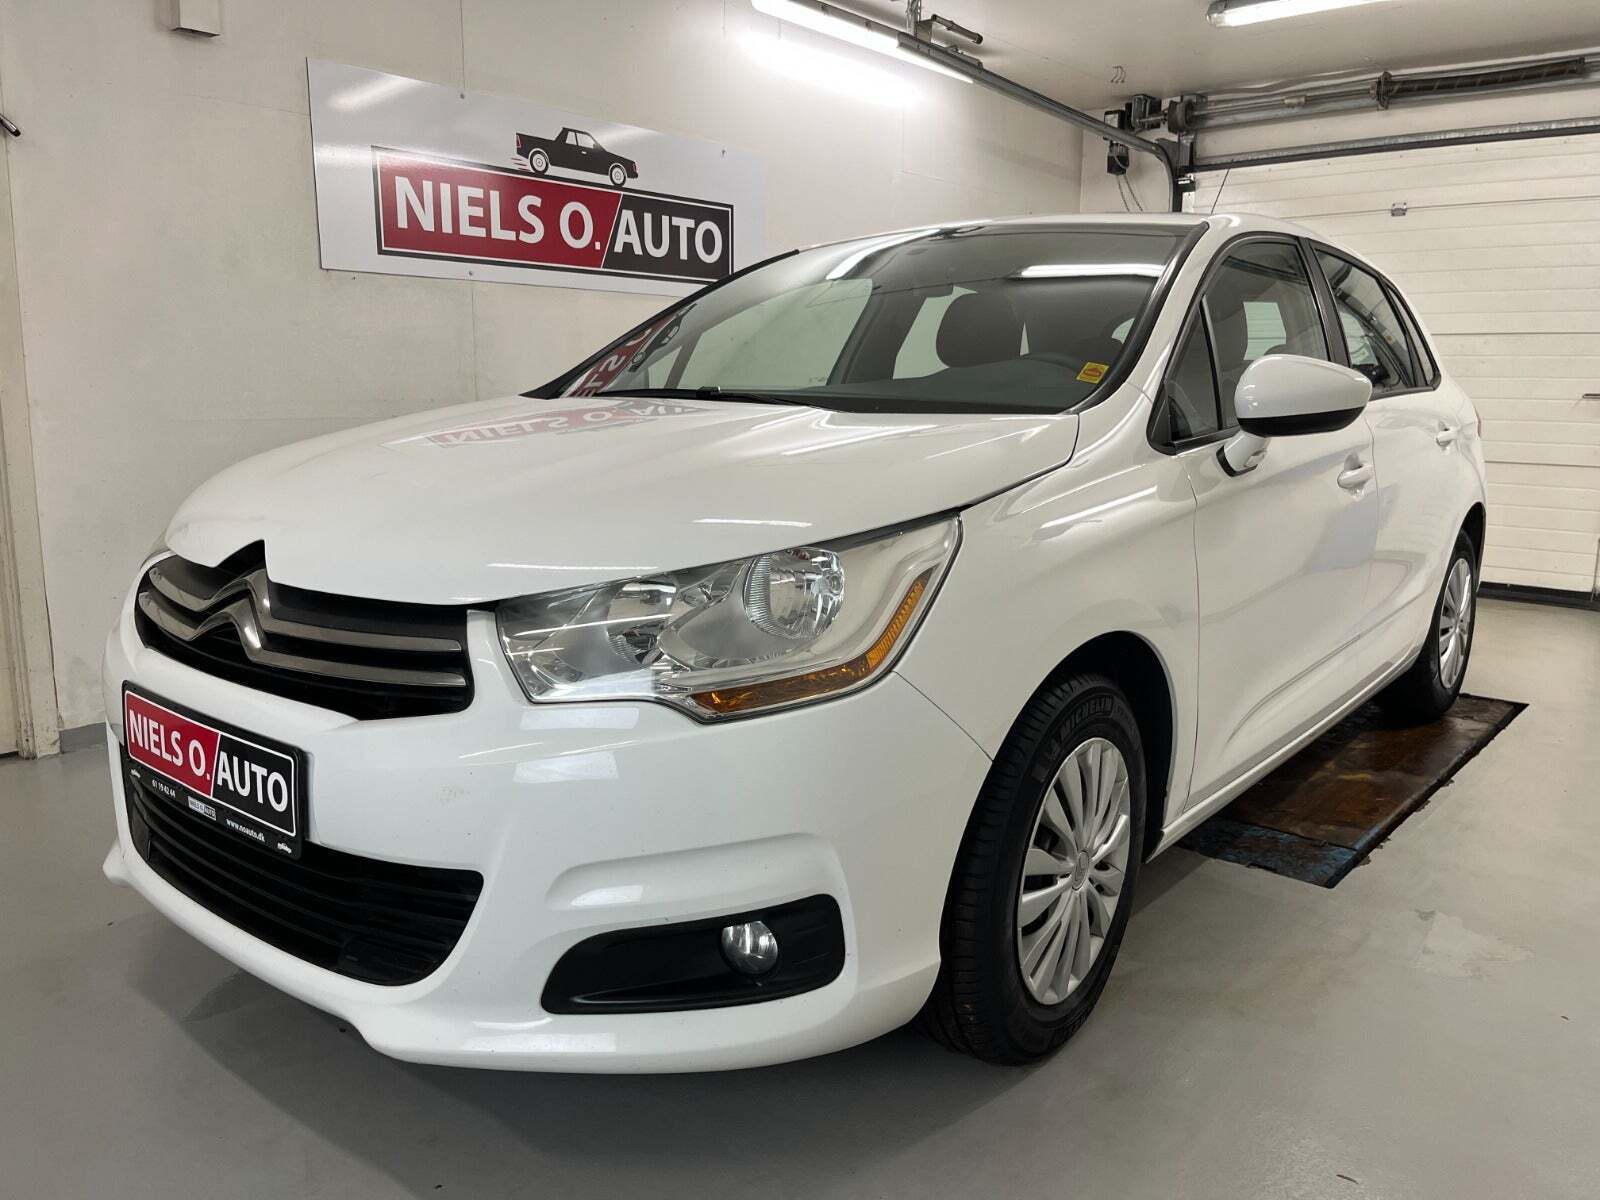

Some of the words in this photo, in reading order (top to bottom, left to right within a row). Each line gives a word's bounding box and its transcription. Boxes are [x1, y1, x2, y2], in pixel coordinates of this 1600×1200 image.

[394, 175, 544, 243] NIELS
[559, 201, 602, 250] O.
[613, 209, 723, 264] AUTO
[129, 709, 183, 767] NIELS
[188, 739, 211, 780] O.
[217, 751, 288, 812] AUTO
